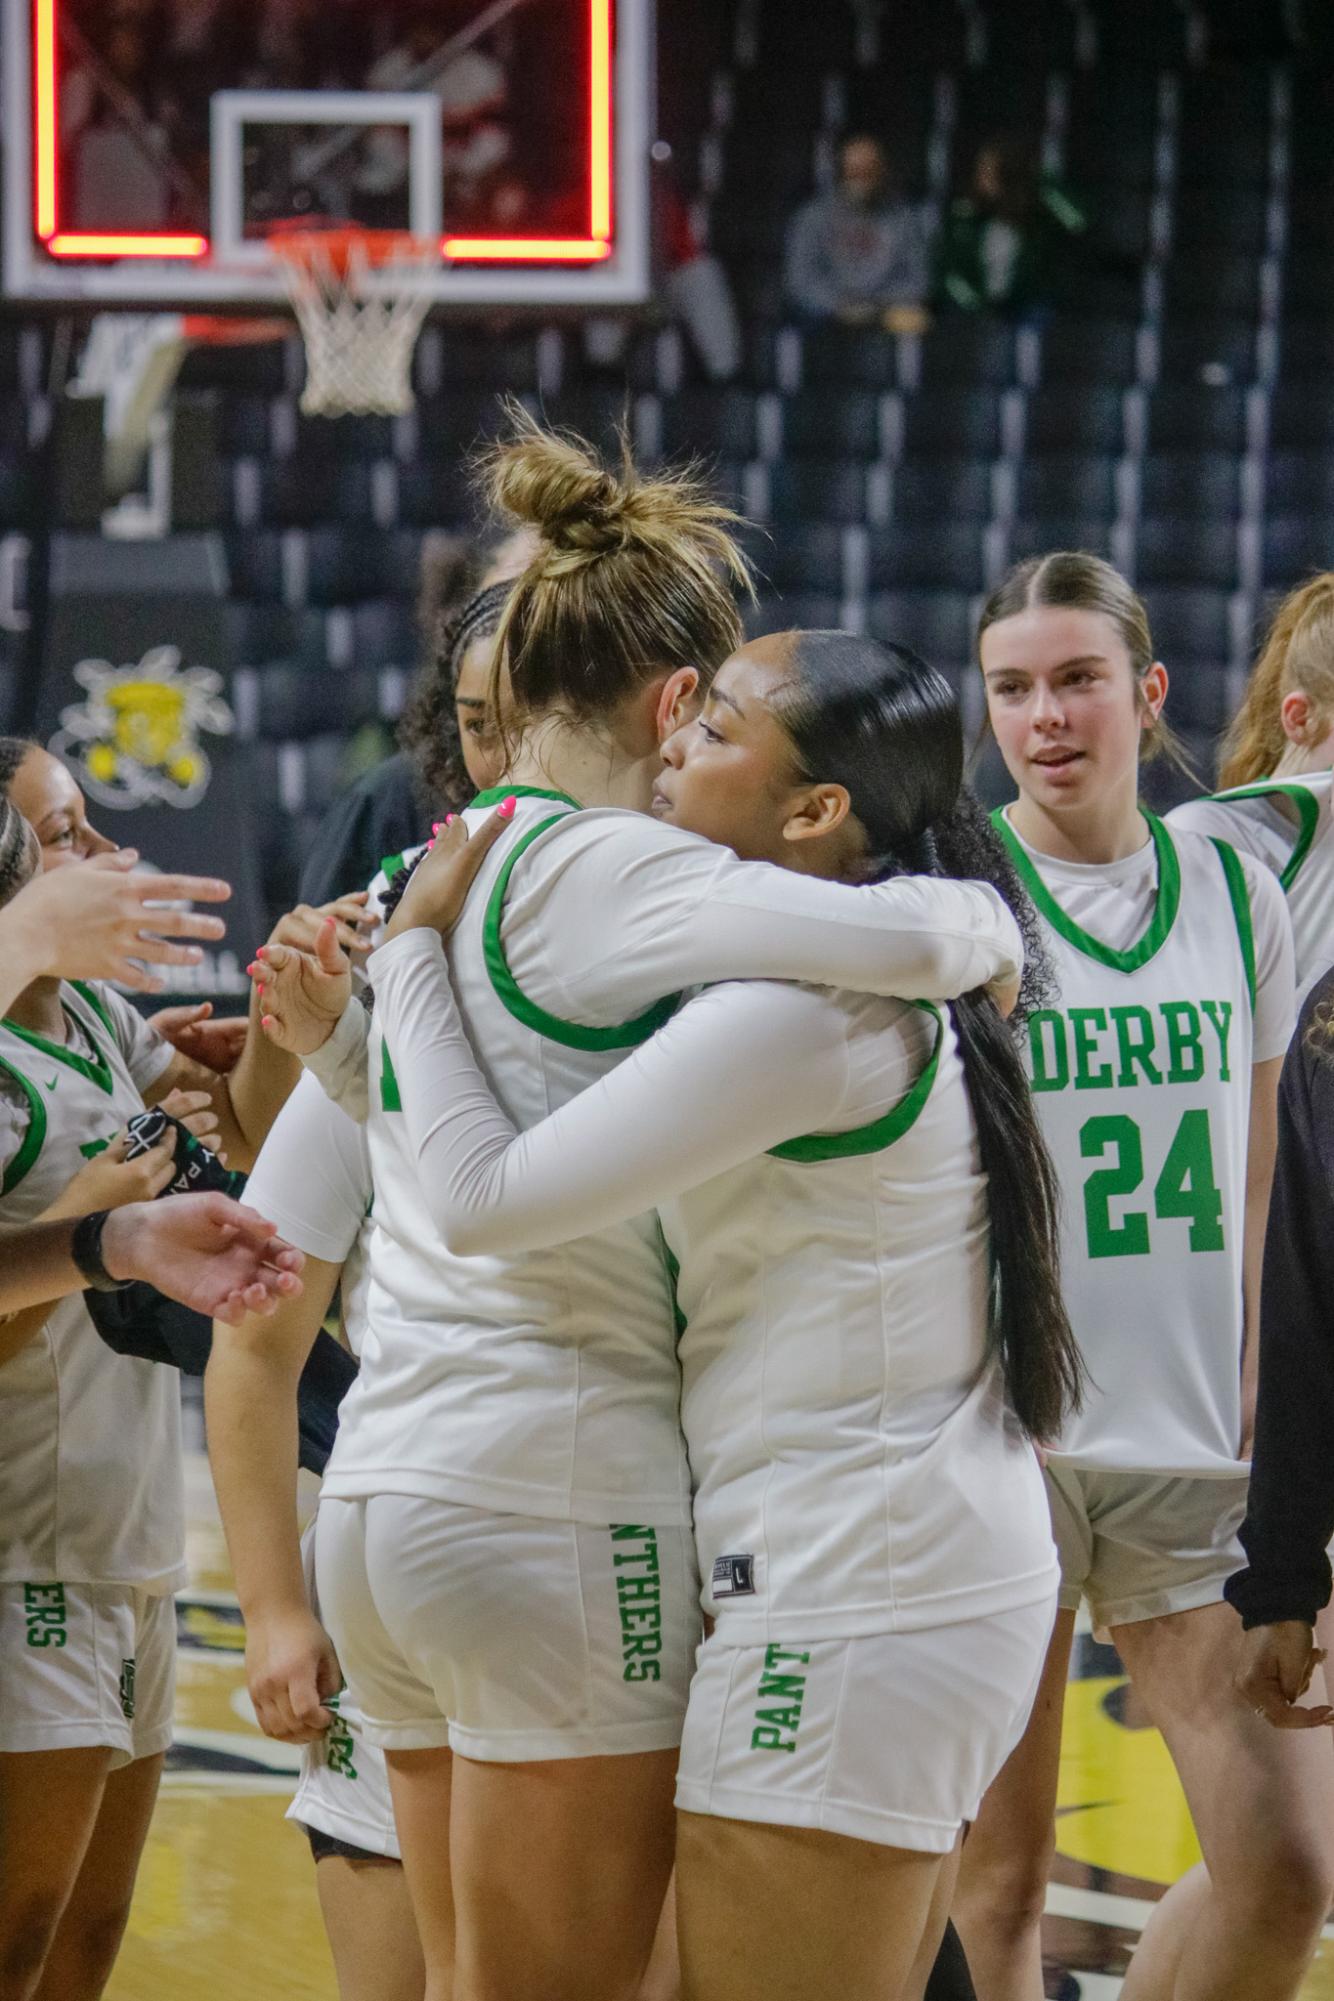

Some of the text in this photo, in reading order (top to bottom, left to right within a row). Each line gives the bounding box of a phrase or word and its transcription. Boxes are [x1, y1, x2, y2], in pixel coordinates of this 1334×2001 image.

[1027, 1001, 1232, 1093] DERBY
[1079, 1109, 1224, 1259] 24
[24, 1582, 67, 1648] ERS
[751, 1643, 810, 1754] PANT
